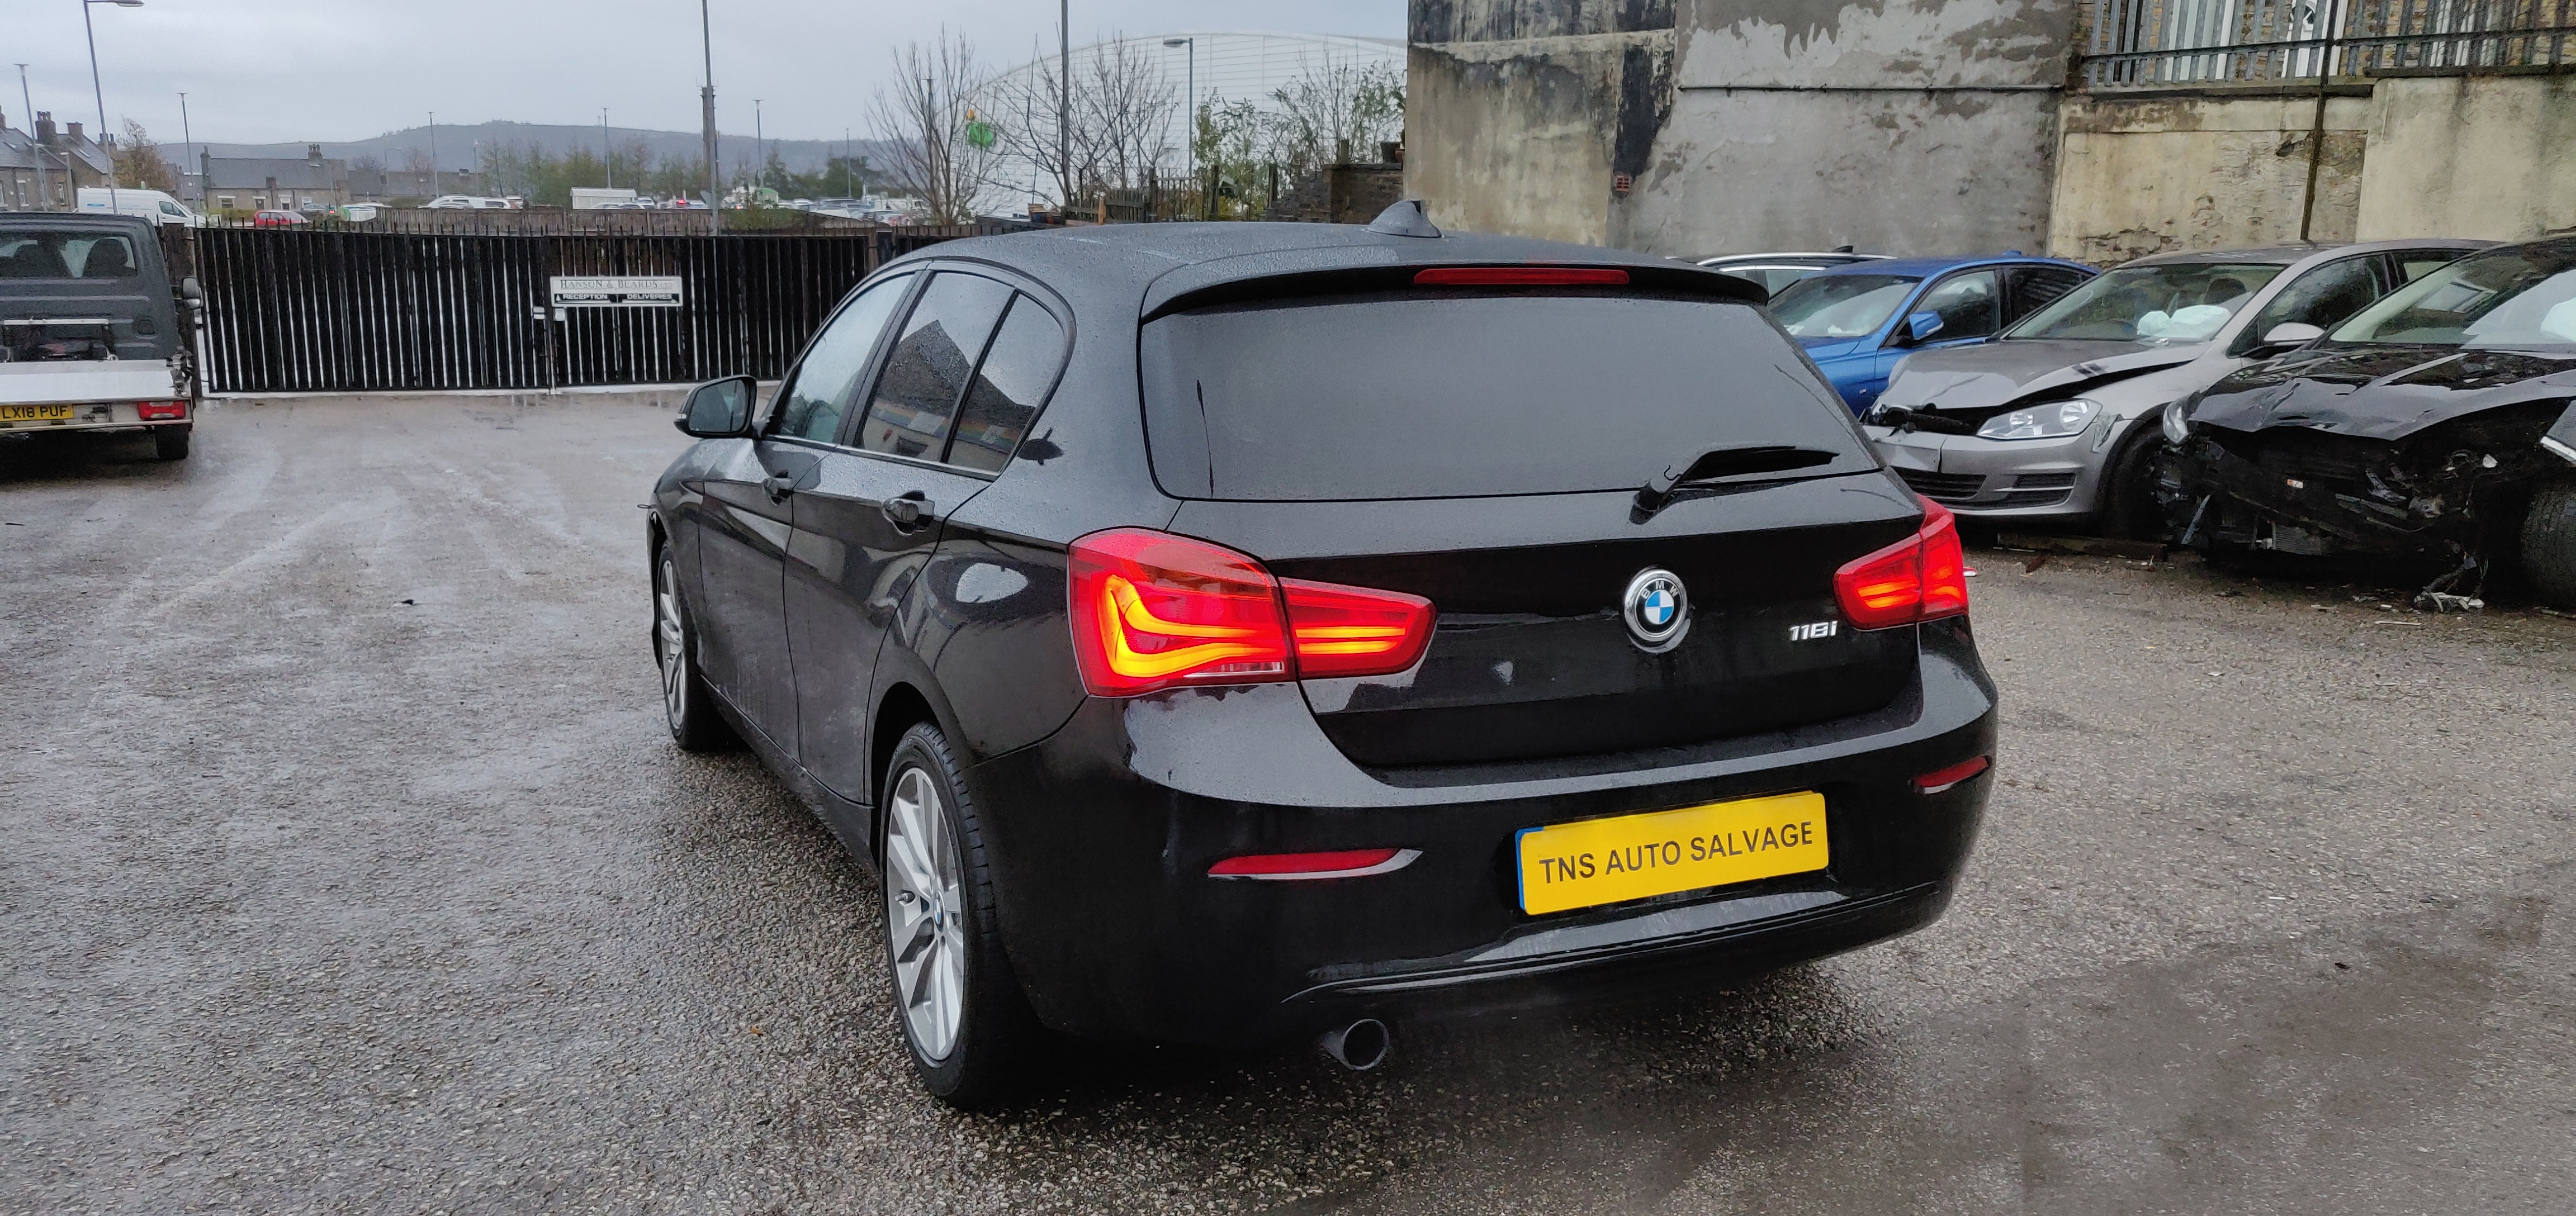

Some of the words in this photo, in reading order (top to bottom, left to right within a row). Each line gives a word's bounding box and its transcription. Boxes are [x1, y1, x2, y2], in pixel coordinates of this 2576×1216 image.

[561, 279, 603, 288] HANSON
[607, 280, 614, 288] &
[1, 406, 35, 419] LX18
[39, 405, 68, 417] PUF
[1641, 580, 1679, 599] BMW
[1789, 620, 1838, 641] 118i
[1538, 852, 1595, 884] TNS
[1605, 840, 1681, 875] AUTO
[1690, 821, 1813, 862] SALVAGE
